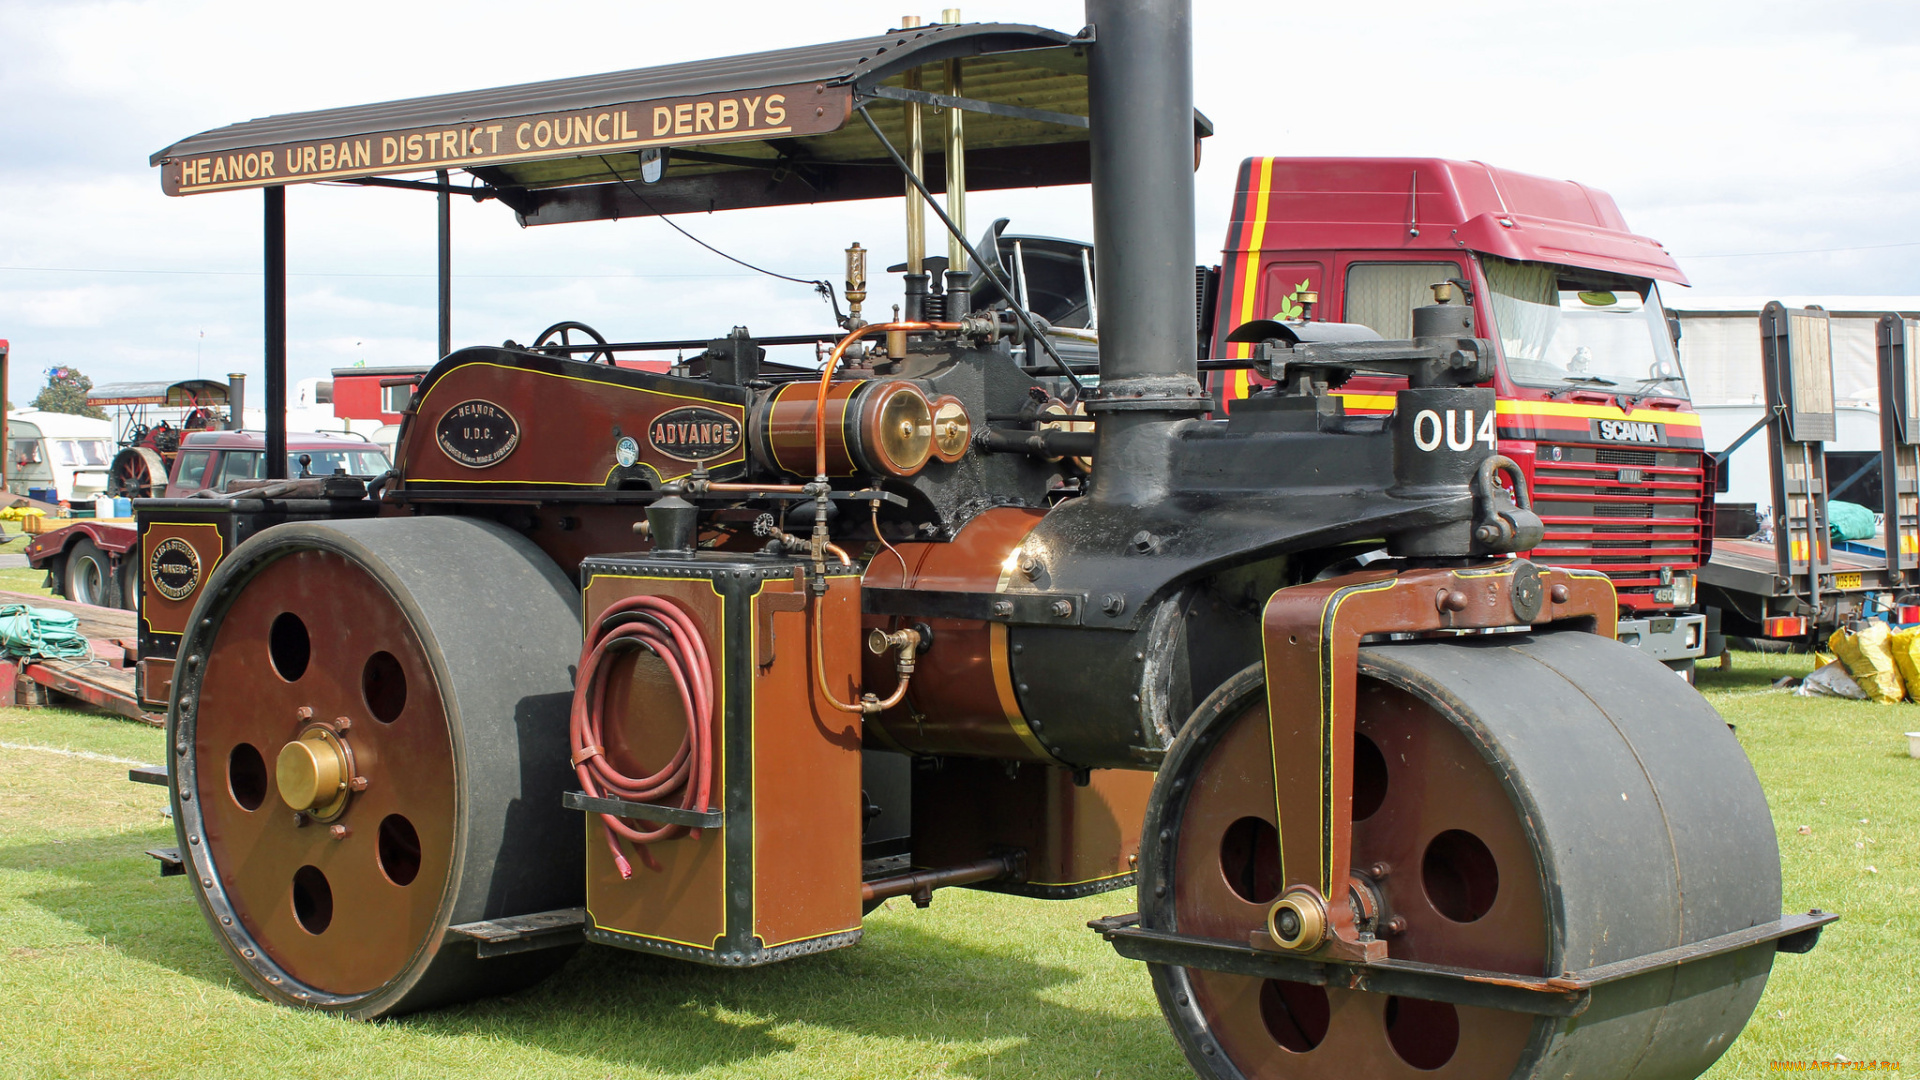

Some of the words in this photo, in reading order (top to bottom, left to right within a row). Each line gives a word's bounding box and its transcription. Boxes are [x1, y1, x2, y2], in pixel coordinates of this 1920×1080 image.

[182, 150, 275, 185] HEANOR
[286, 139, 371, 173] URBAN
[382, 120, 503, 164] DISTRICT
[515, 110, 638, 150] COUNCIL
[653, 94, 787, 137] DERBYS
[458, 404, 495, 417] HEANOR
[463, 427, 494, 440] U.D.C.
[655, 423, 734, 444] ADVANCE
[1413, 409, 1498, 452] OU4
[1600, 420, 1659, 442] SCANIA
[162, 563, 188, 574] MAKERS
[1655, 589, 1674, 601] 450
